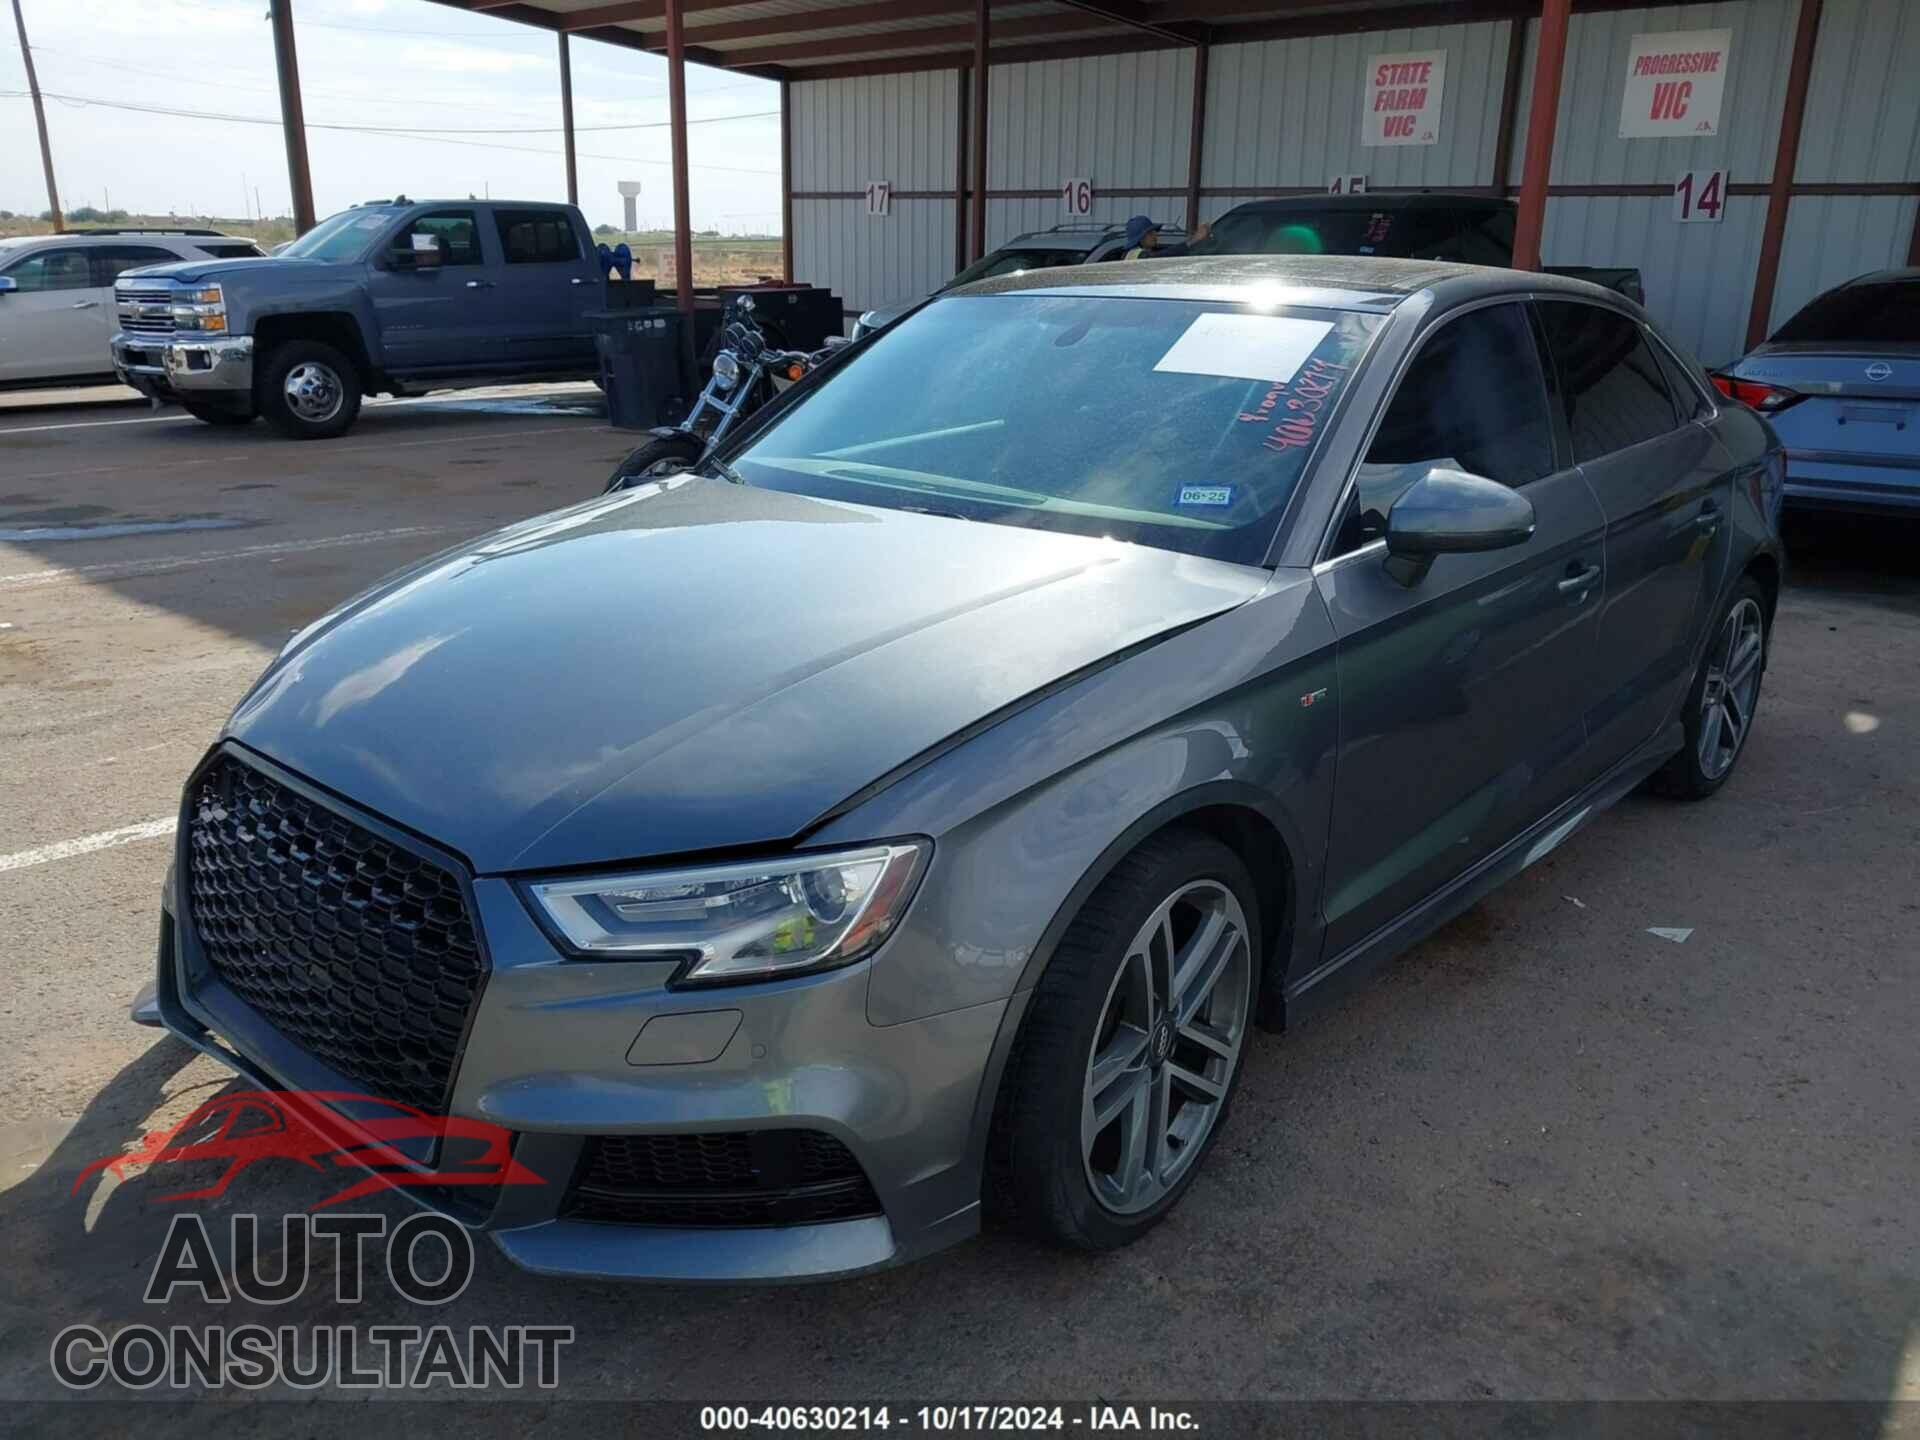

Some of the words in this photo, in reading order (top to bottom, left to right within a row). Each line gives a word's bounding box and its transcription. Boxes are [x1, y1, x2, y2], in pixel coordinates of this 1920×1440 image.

[1375, 62, 1432, 86] STATE
[1633, 52, 1721, 75] PROGRESSIVE
[1374, 88, 1427, 112] FARM
[1649, 81, 1693, 120] VIC
[1384, 115, 1416, 137] VIC
[866, 184, 888, 213] 17
[1064, 181, 1089, 213] 16
[1676, 171, 1721, 219] 14
